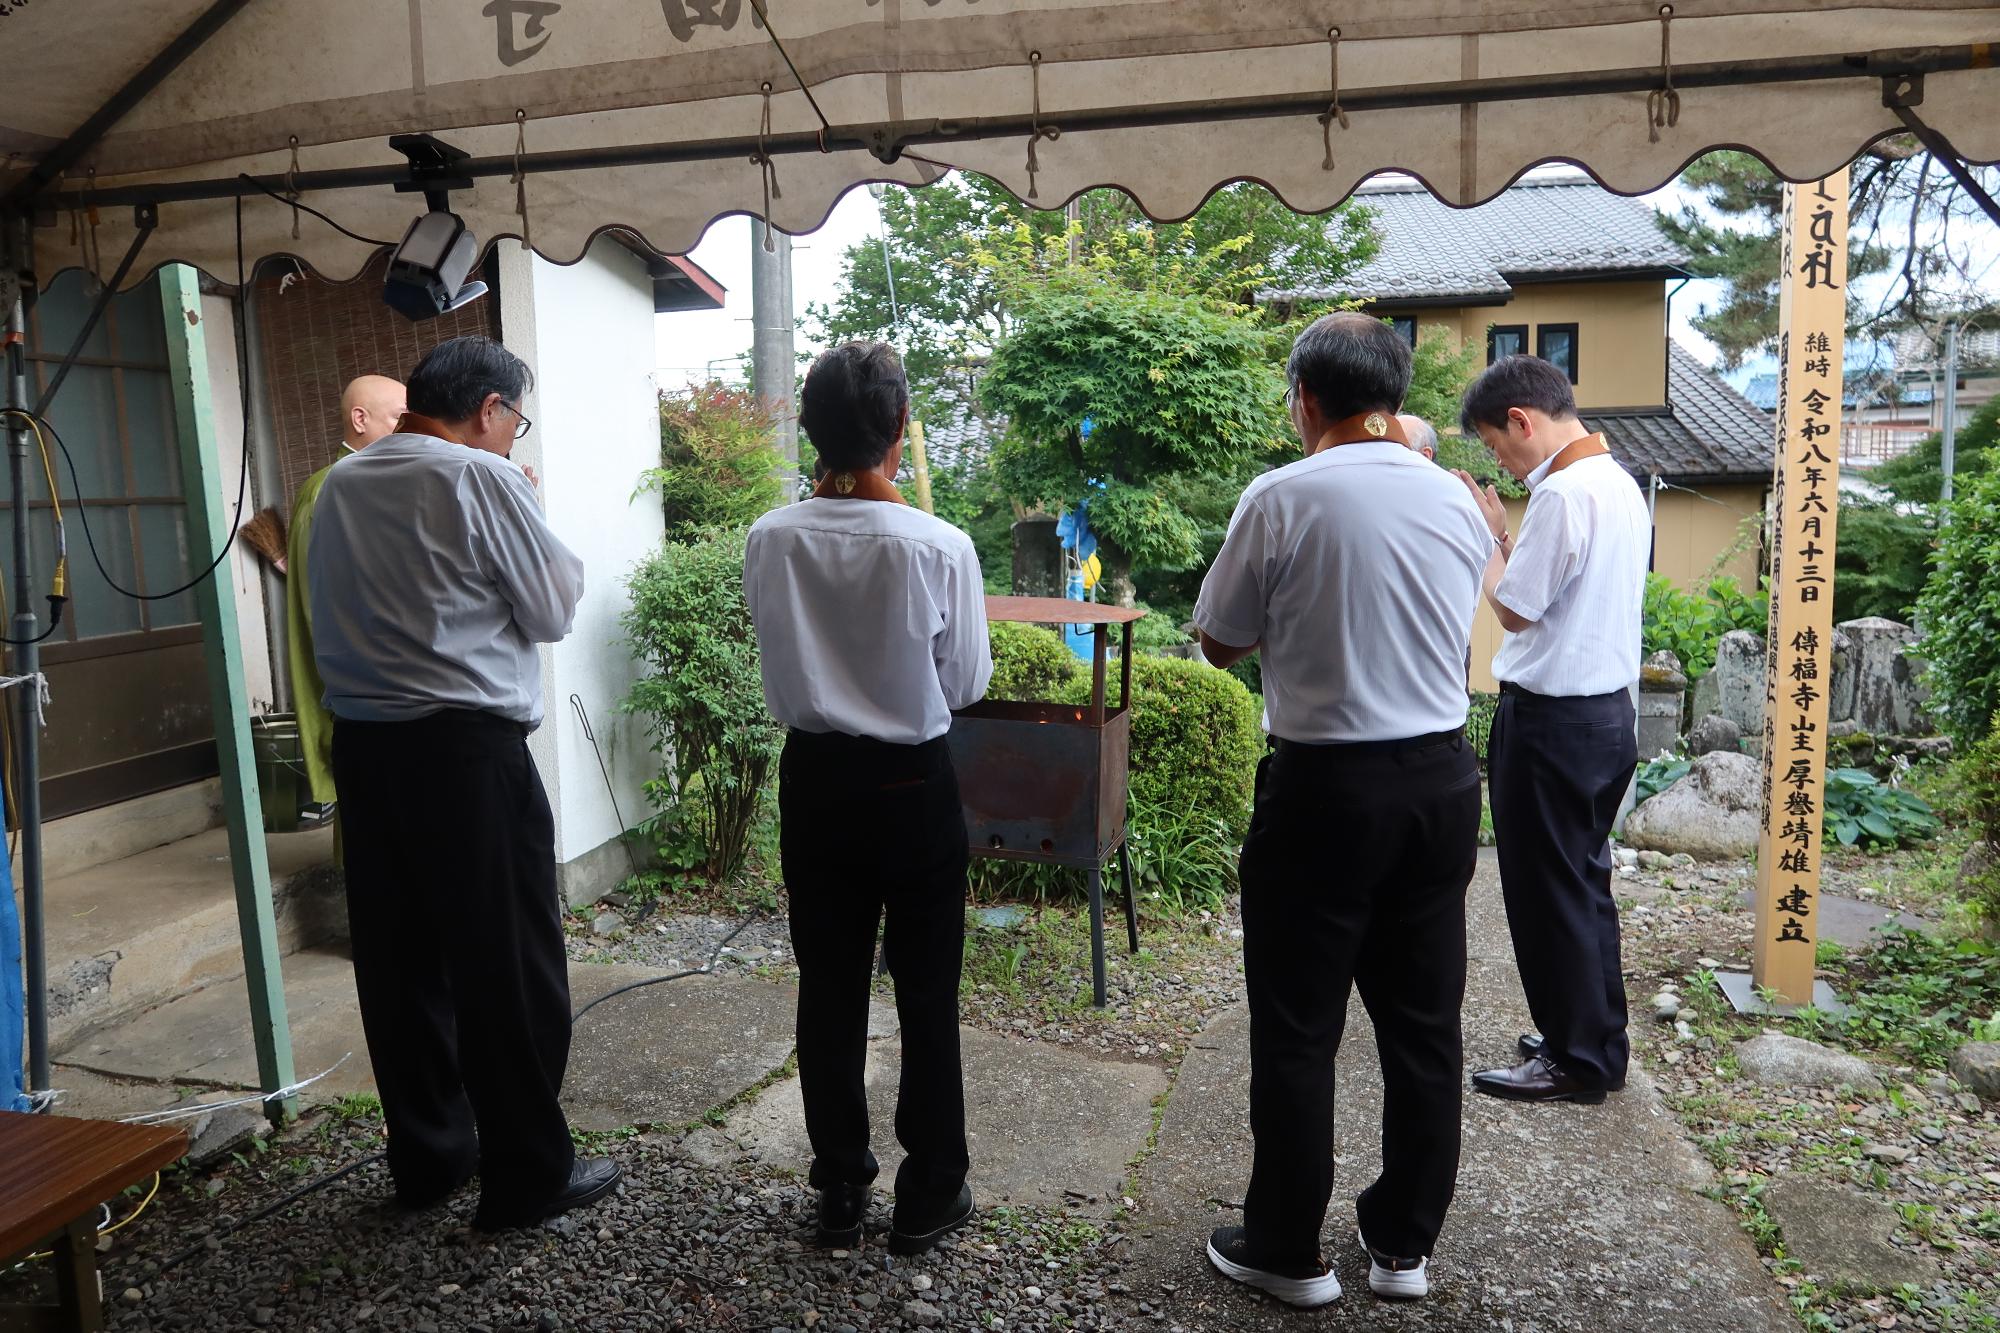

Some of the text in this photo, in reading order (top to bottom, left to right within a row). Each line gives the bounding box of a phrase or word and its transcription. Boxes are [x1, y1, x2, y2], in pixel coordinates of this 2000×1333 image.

[1803, 331, 1832, 378] 維時
[1796, 388, 1832, 604] 令和八年六月十三日
[1775, 883, 1813, 944] 建立
